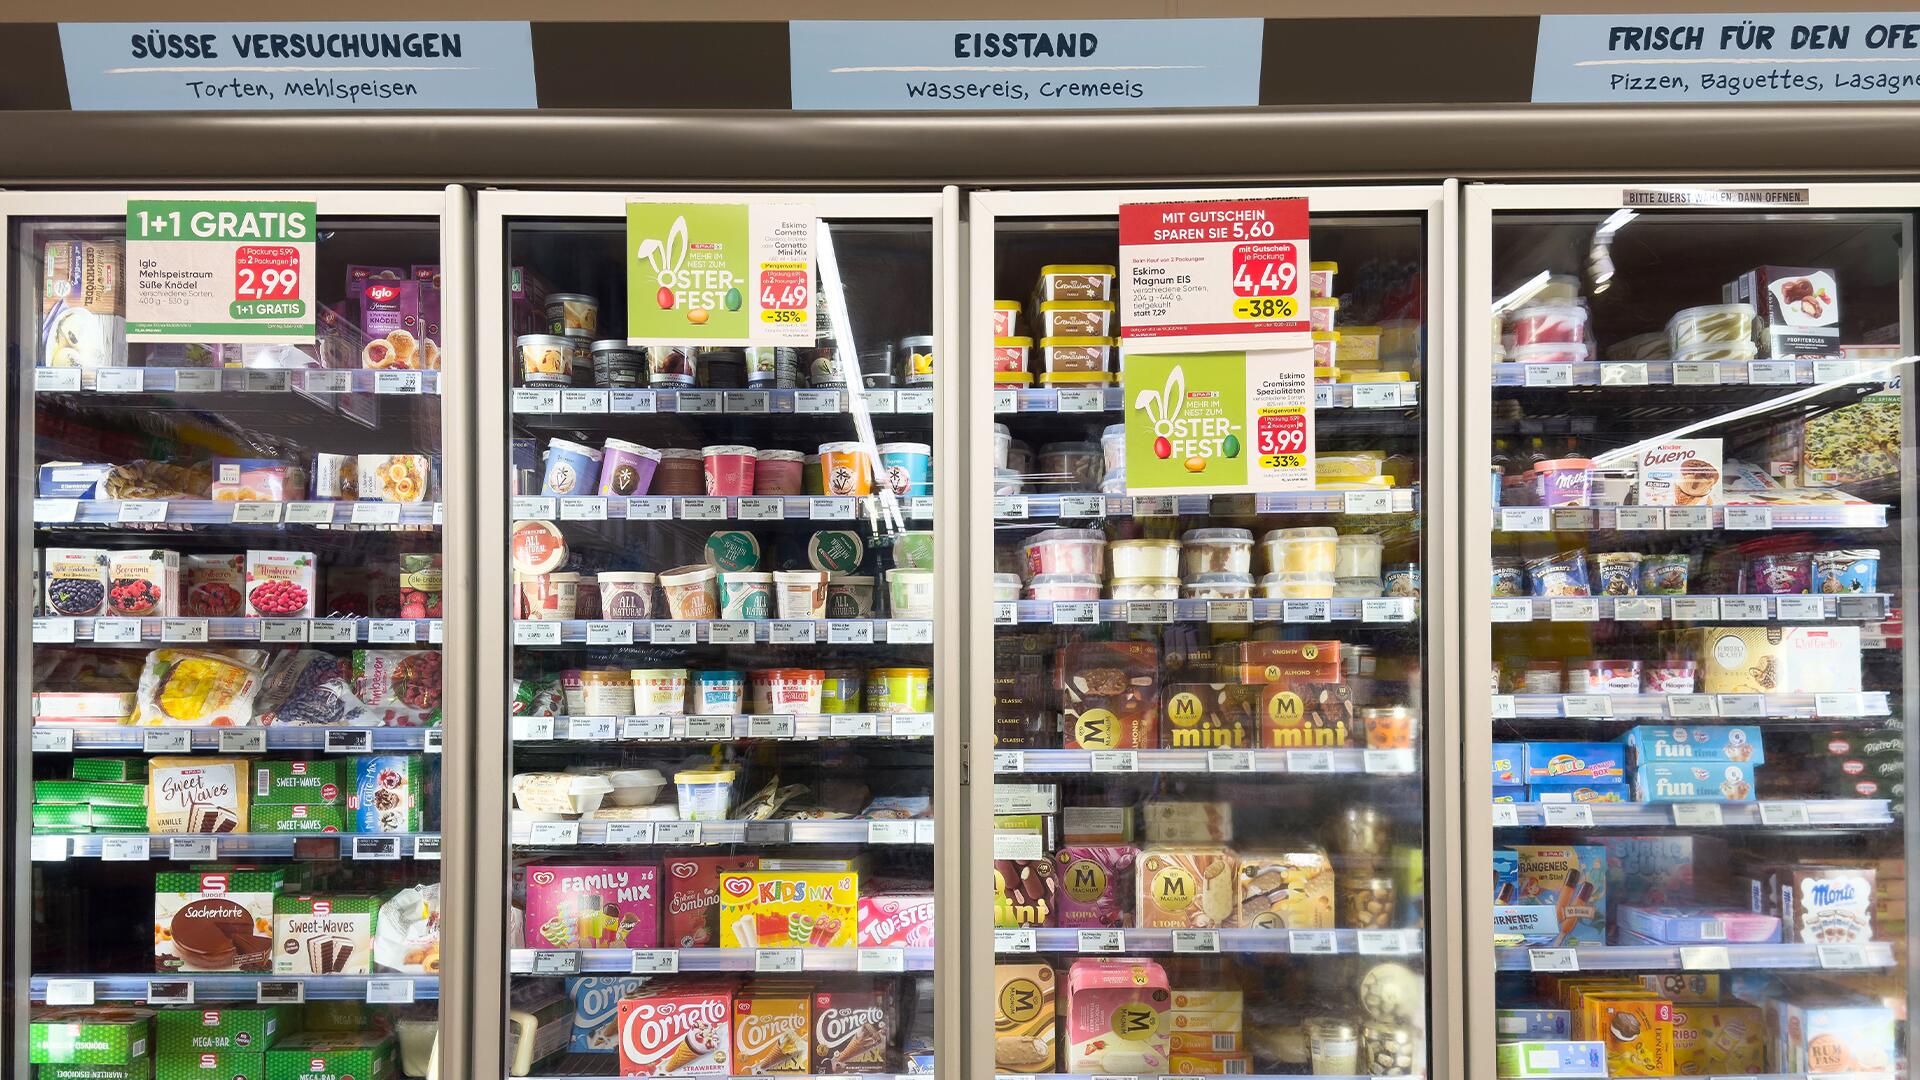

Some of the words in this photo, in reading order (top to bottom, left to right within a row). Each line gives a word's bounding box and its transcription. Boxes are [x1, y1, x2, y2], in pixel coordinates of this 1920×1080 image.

[1608, 26, 1704, 51] FRISCH
[1720, 20, 1775, 50] FÜR
[1791, 25, 1849, 50] DEN
[131, 33, 217, 59] SÜSSE
[233, 33, 461, 59] VERSUCHUNGEN
[954, 33, 1098, 58] EISSTAND
[1610, 74, 1689, 92] Pizzen,
[1701, 69, 1824, 96] Baguettes,
[186, 81, 275, 102] Torten,
[284, 77, 417, 104] Mehlspeisen
[906, 80, 1029, 101] Wassereis,
[1039, 79, 1144, 99] Cremeeis
[1629, 192, 1655, 204] BITTE
[1658, 192, 1692, 204] ZUERST
[1738, 192, 1763, 203] DANN
[1162, 212, 1185, 223] MIT
[1189, 210, 1265, 223] GUTSCHEIN
[136, 211, 181, 237] 1+1
[190, 211, 306, 238] GRATIS
[1154, 229, 1206, 241] SPAREN
[1209, 228, 1228, 239] SIE
[1233, 222, 1275, 240] 5,60
[247, 248, 278, 257] Packung
[1252, 245, 1290, 253] Gutschein
[139, 259, 157, 269] Iglo
[247, 256, 253, 264] 2
[289, 256, 299, 267] je
[1253, 253, 1285, 262] Packung
[85, 246, 96, 306] GERMKNÖDEL
[139, 270, 213, 281] Mehlspeistraum
[1133, 267, 1166, 276] Eskimo
[139, 280, 163, 290] Süße
[164, 280, 198, 290] Knödel
[238, 268, 297, 299] 2,99
[1133, 277, 1174, 288] Magnum
[1176, 275, 1191, 284] EIS
[1233, 262, 1297, 296] 4,49
[371, 287, 393, 299] iglo
[761, 286, 807, 309] 4,49
[675, 291, 727, 310] FEST
[236, 305, 253, 315] 1+1
[256, 304, 300, 315] GRATIS
[1134, 309, 1151, 317] statt
[1152, 309, 1167, 317] 7,29
[1238, 299, 1292, 318] -38%
[369, 315, 398, 324] KNÖDEL
[767, 311, 801, 323] -35%
[1262, 380, 1306, 388] Cremissimo
[1256, 388, 1306, 396] Spezialitäten
[1172, 439, 1224, 459] FEST
[1260, 429, 1304, 455] 3,99
[1265, 455, 1300, 467] -33%
[1643, 450, 1696, 467] bueno
[525, 536, 540, 545] ALL
[619, 596, 636, 608] ALL
[691, 595, 707, 608] ALL
[753, 595, 767, 607] ALL
[1171, 722, 1244, 747] mini
[1273, 721, 1345, 747] mini
[1654, 740, 1693, 757] fun
[1592, 768, 1609, 778] BOX
[162, 775, 204, 801] Sweet
[276, 777, 321, 787] SWEET-WAVES
[1656, 778, 1694, 796] fun
[181, 784, 230, 808] Waves
[157, 817, 182, 826] VANILLE
[276, 819, 321, 830] SWEET-WAVES
[561, 871, 629, 893] FAMILY
[641, 871, 654, 881] x6
[839, 877, 851, 890] x8
[617, 884, 651, 904] MIX
[758, 880, 806, 904] KIDS
[808, 886, 833, 901] MIX
[1811, 884, 1856, 906] Monte
[185, 905, 243, 919] Sachertorte
[1064, 911, 1098, 919] UTOPIA
[288, 919, 354, 933] Sweet-Waves
[1152, 920, 1187, 928] UTOPIA
[623, 1000, 726, 1065] Cornetto
[736, 1013, 806, 1056] Cornetto
[816, 1007, 884, 1049] Cornetto
[192, 1037, 230, 1048] MEGA-BAR
